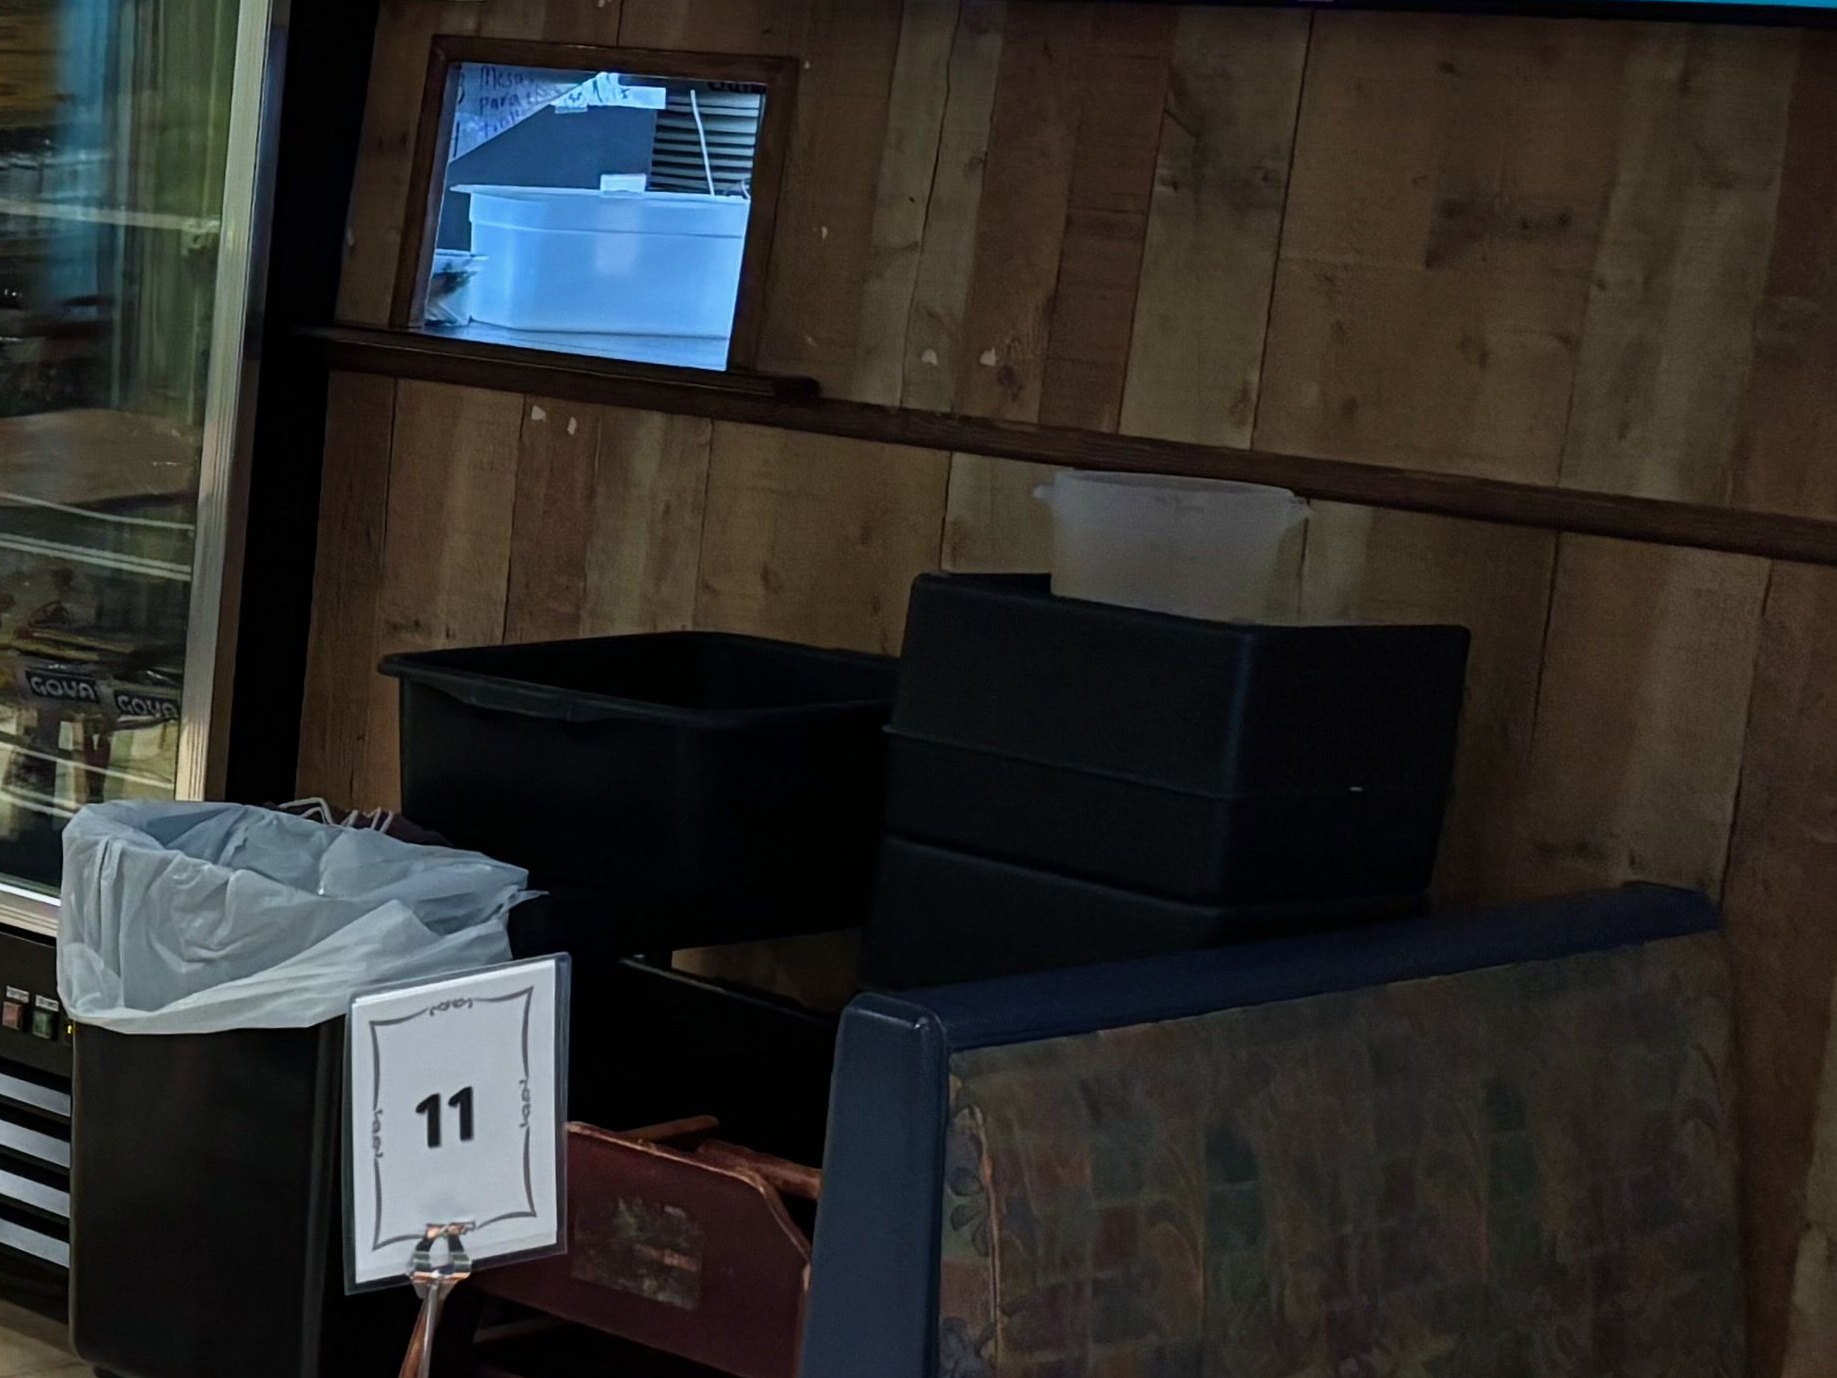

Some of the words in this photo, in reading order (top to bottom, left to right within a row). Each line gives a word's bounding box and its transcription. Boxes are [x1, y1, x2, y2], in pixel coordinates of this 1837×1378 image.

[30, 675, 96, 701] GOYA
[116, 694, 178, 720] GOYA
[415, 1086, 475, 1148] 11
